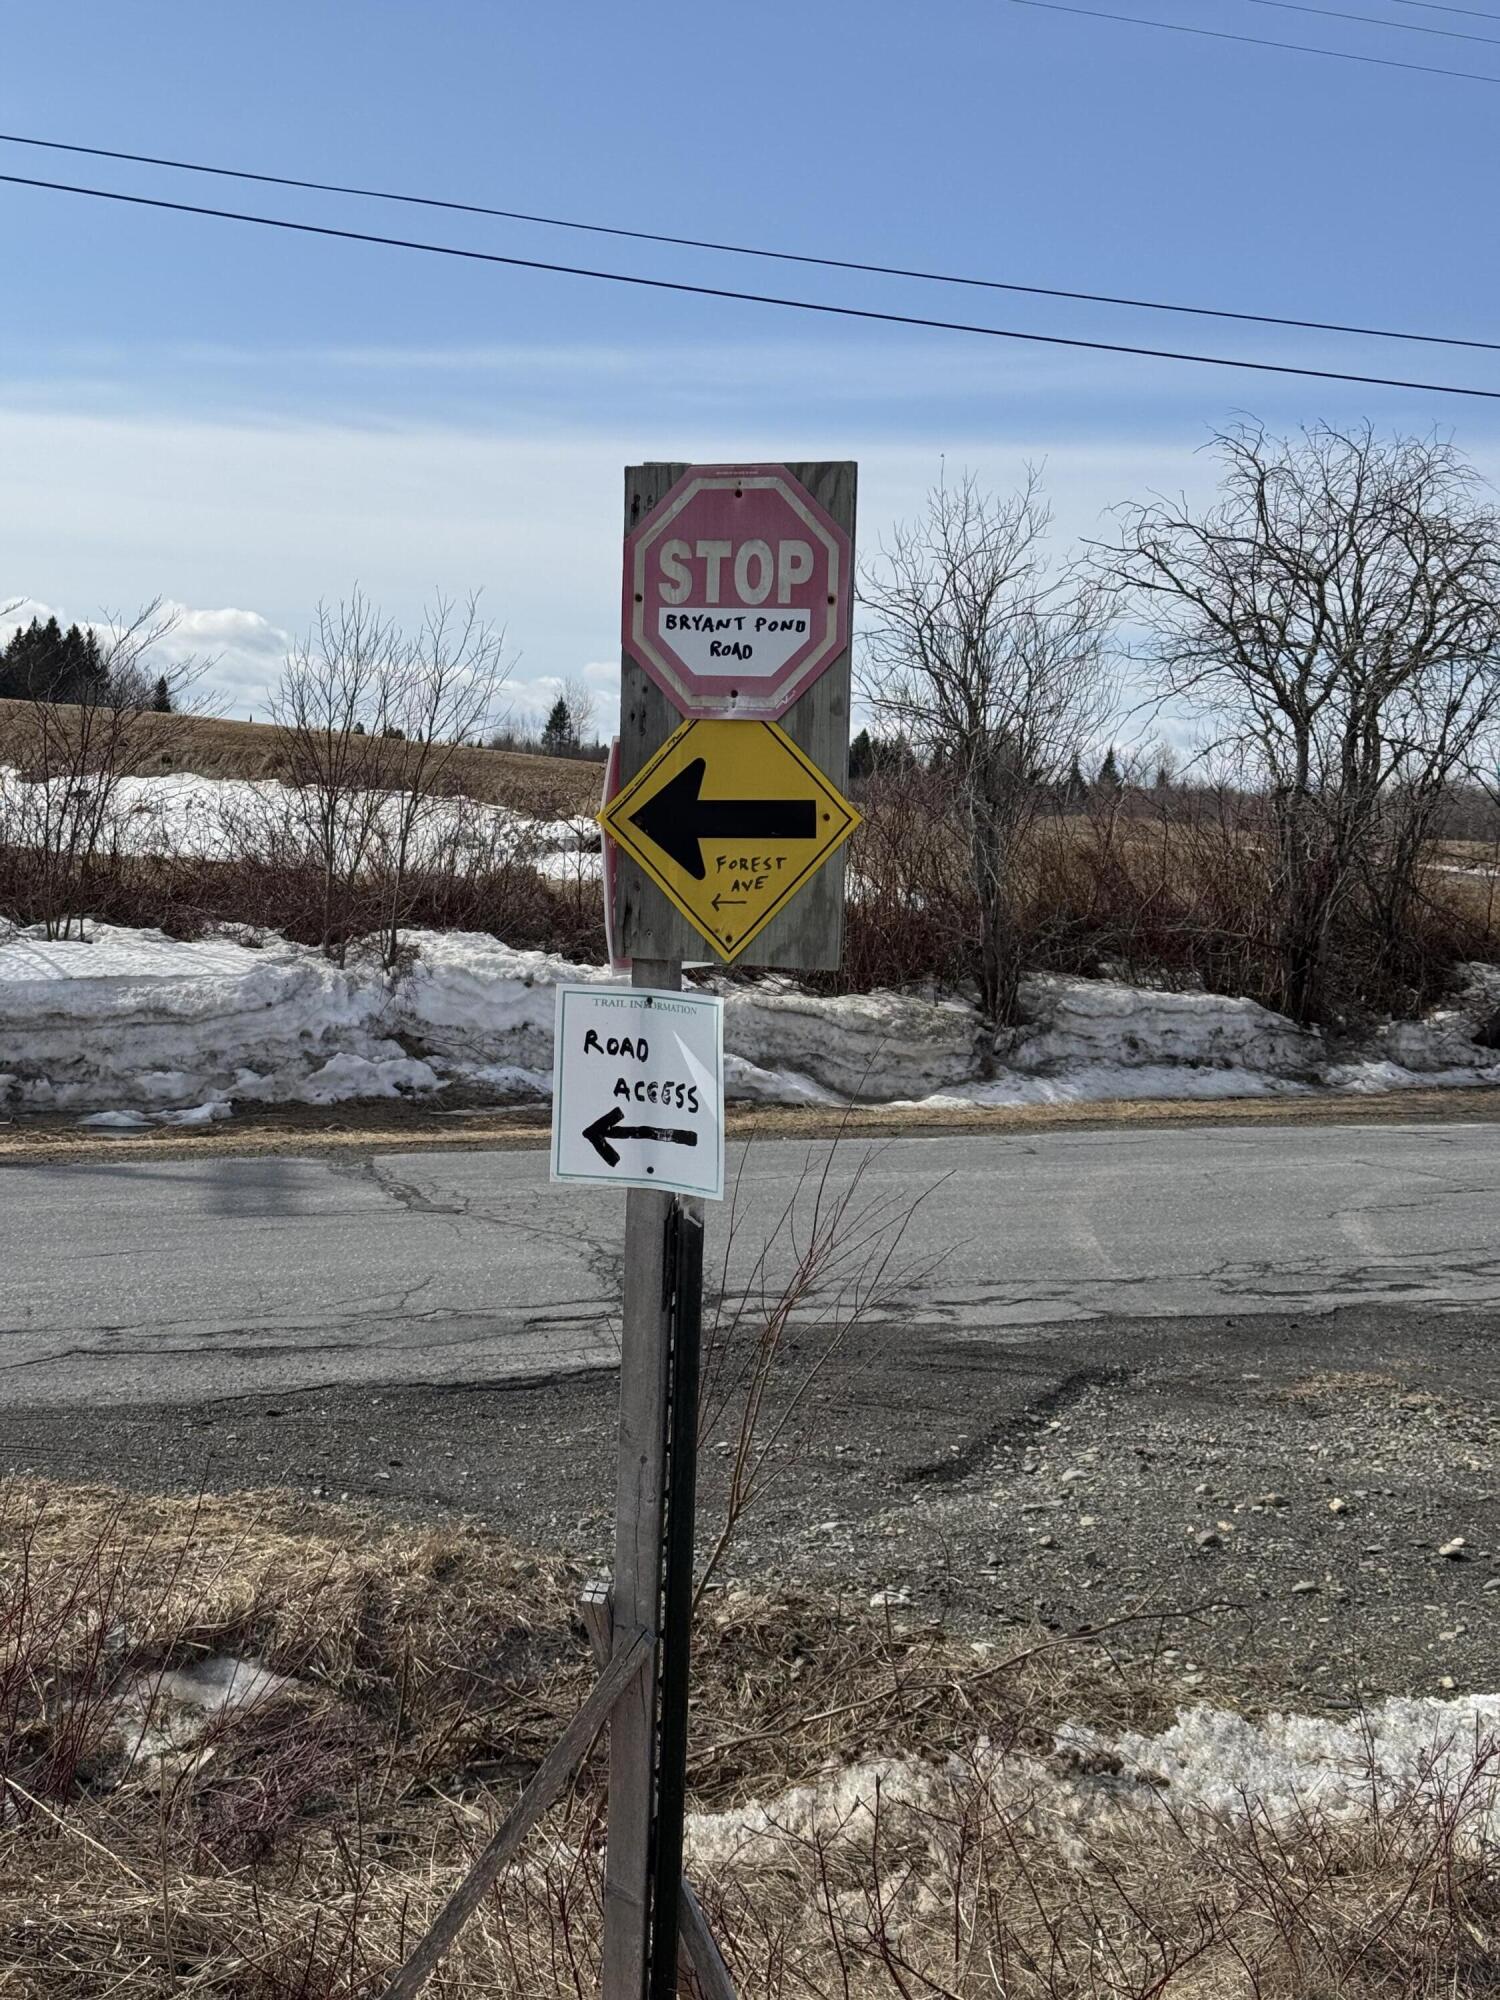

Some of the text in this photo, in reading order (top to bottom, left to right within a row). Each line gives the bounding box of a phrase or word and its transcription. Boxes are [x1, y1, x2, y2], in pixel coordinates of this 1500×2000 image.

[658, 539, 814, 605] STOP
[665, 614, 806, 633] BRYANT POND
[709, 640, 753, 660] ROAD
[716, 855, 787, 874] FOREST
[731, 875, 769, 892] AVE
[592, 998, 627, 1009] TRAIL
[583, 1029, 649, 1063] ROAD
[613, 1078, 699, 1114] ACCESS
